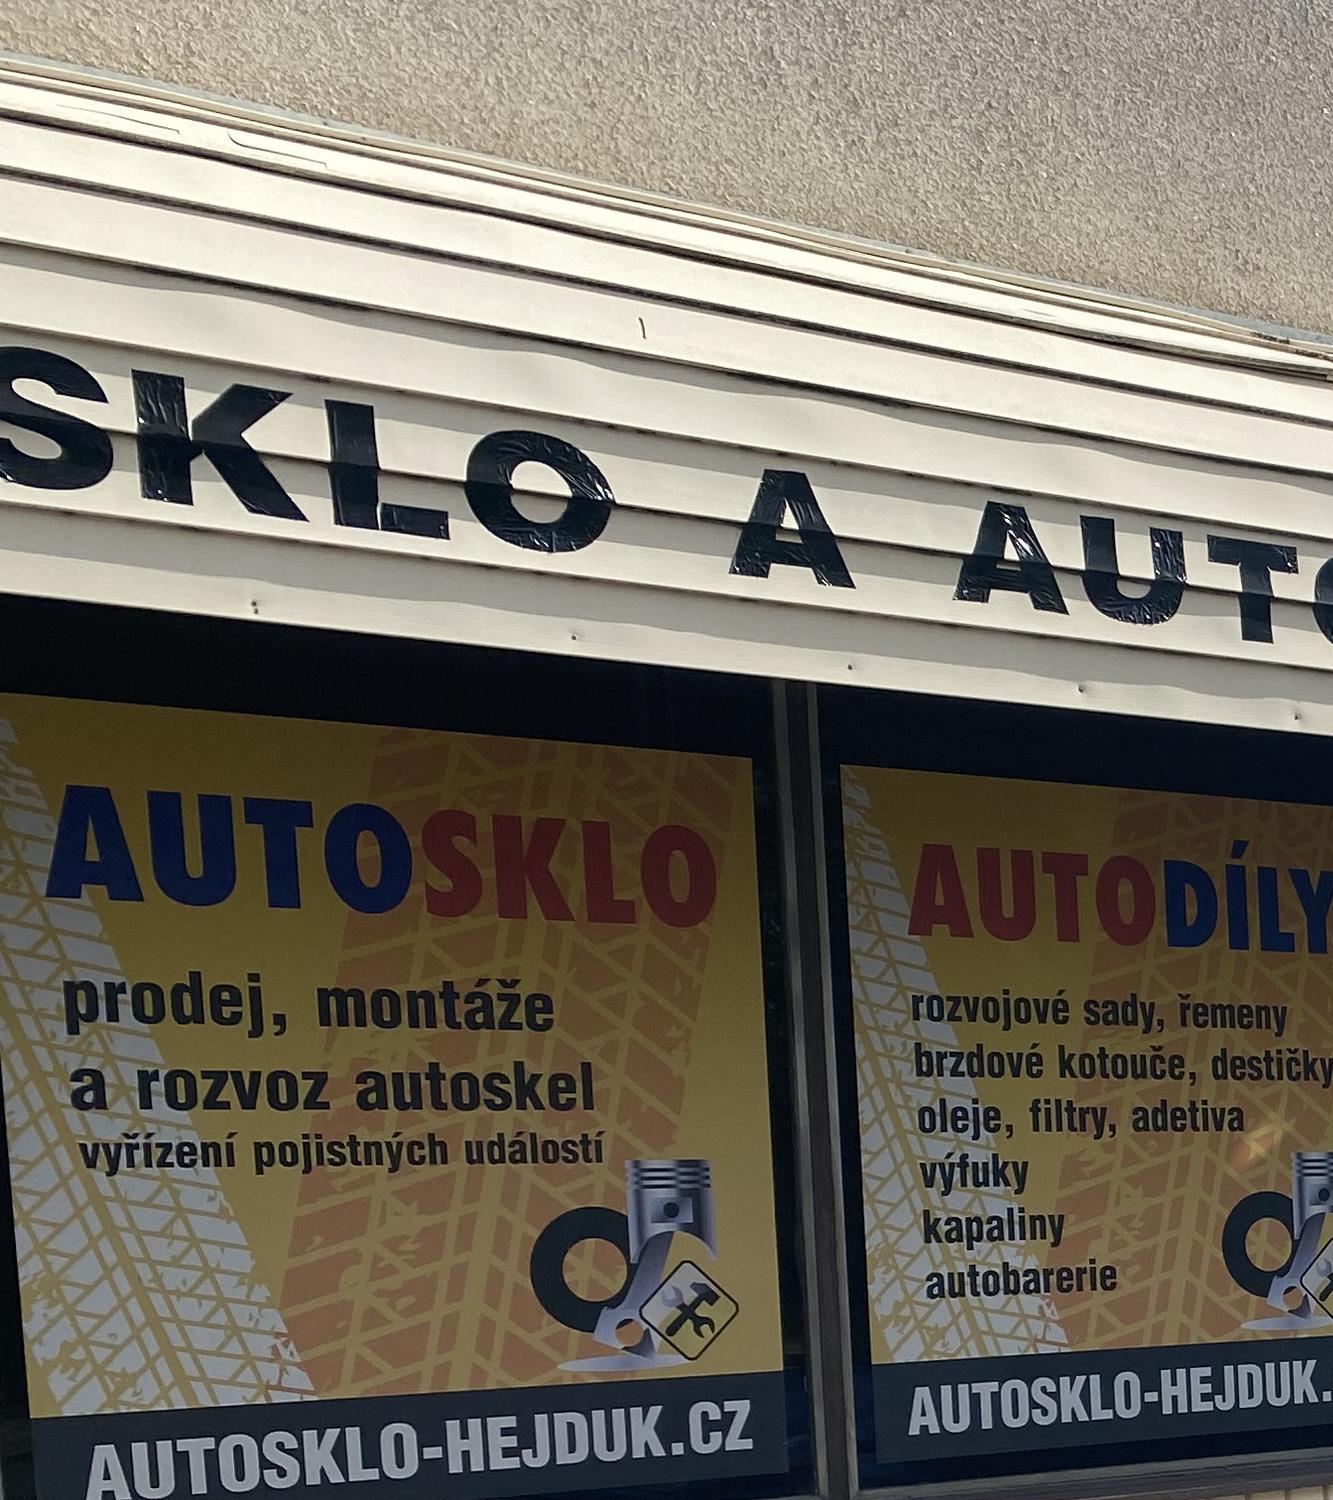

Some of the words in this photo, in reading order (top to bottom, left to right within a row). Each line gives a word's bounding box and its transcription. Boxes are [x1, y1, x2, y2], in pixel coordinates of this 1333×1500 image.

[729, 468, 856, 589] A
[44, 785, 717, 928] AUTOSKLO
[63, 971, 288, 1037] prodej,
[317, 978, 555, 1033] montáže
[911, 988, 1070, 1032] rozvojové
[1084, 992, 1165, 1034] sady,
[1178, 992, 1289, 1037] řemeny
[70, 1067, 108, 1112] a
[138, 1067, 331, 1112] rozvoz
[355, 1061, 596, 1112] autoskel
[914, 1042, 1043, 1079] brzdové
[1058, 1043, 1197, 1086] kotouče,
[917, 1099, 1014, 1141] oleje,
[1029, 1099, 1117, 1141] filtry,
[1131, 1099, 1245, 1133] adetiva
[79, 1130, 236, 1177] vyřízení
[253, 1131, 449, 1176] pojistných
[464, 1129, 606, 1166] událostí
[920, 1152, 1029, 1196] výfuky
[922, 1207, 1065, 1251] kapaliny
[926, 1258, 1118, 1300] autobarerie
